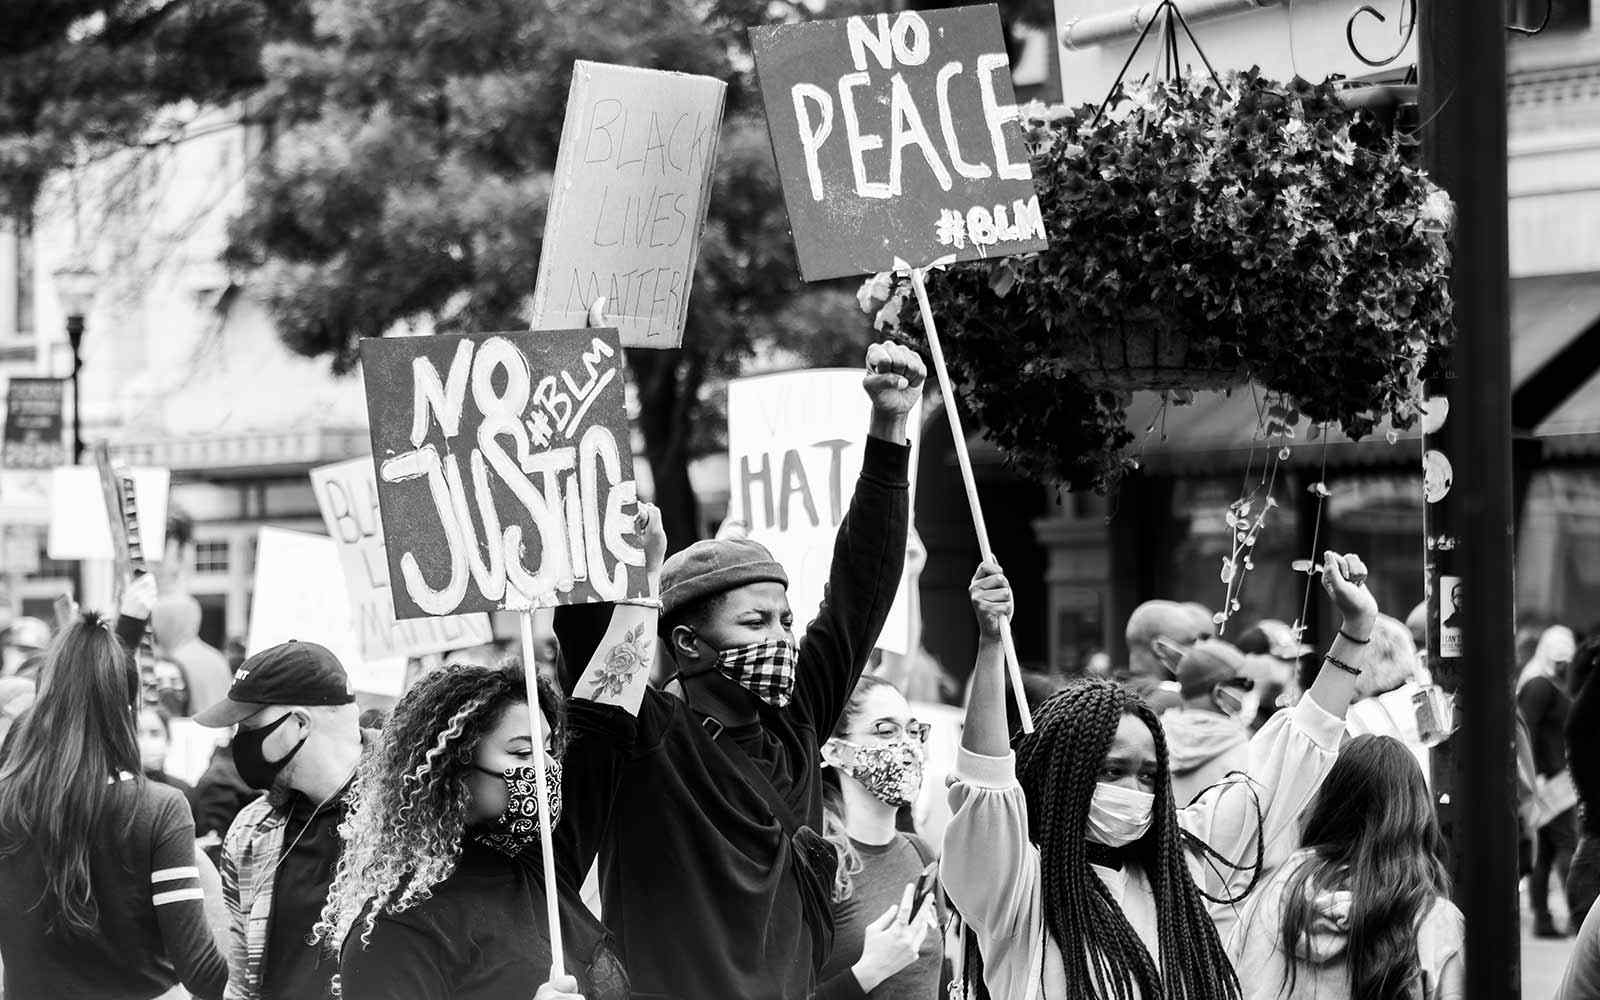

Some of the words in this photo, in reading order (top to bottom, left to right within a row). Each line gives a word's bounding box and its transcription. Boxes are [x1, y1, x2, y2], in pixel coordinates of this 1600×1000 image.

[847, 10, 930, 70] NO
[585, 99, 709, 178] BLACK
[791, 53, 1032, 200] PEACE
[594, 186, 686, 248] LIVES
[935, 195, 1047, 252] #BLM
[565, 267, 681, 337] MATTER
[410, 336, 530, 448] NO
[526, 338, 614, 447] #BLM
[381, 417, 647, 616] JUSTICE
[741, 438, 855, 532] HAT
